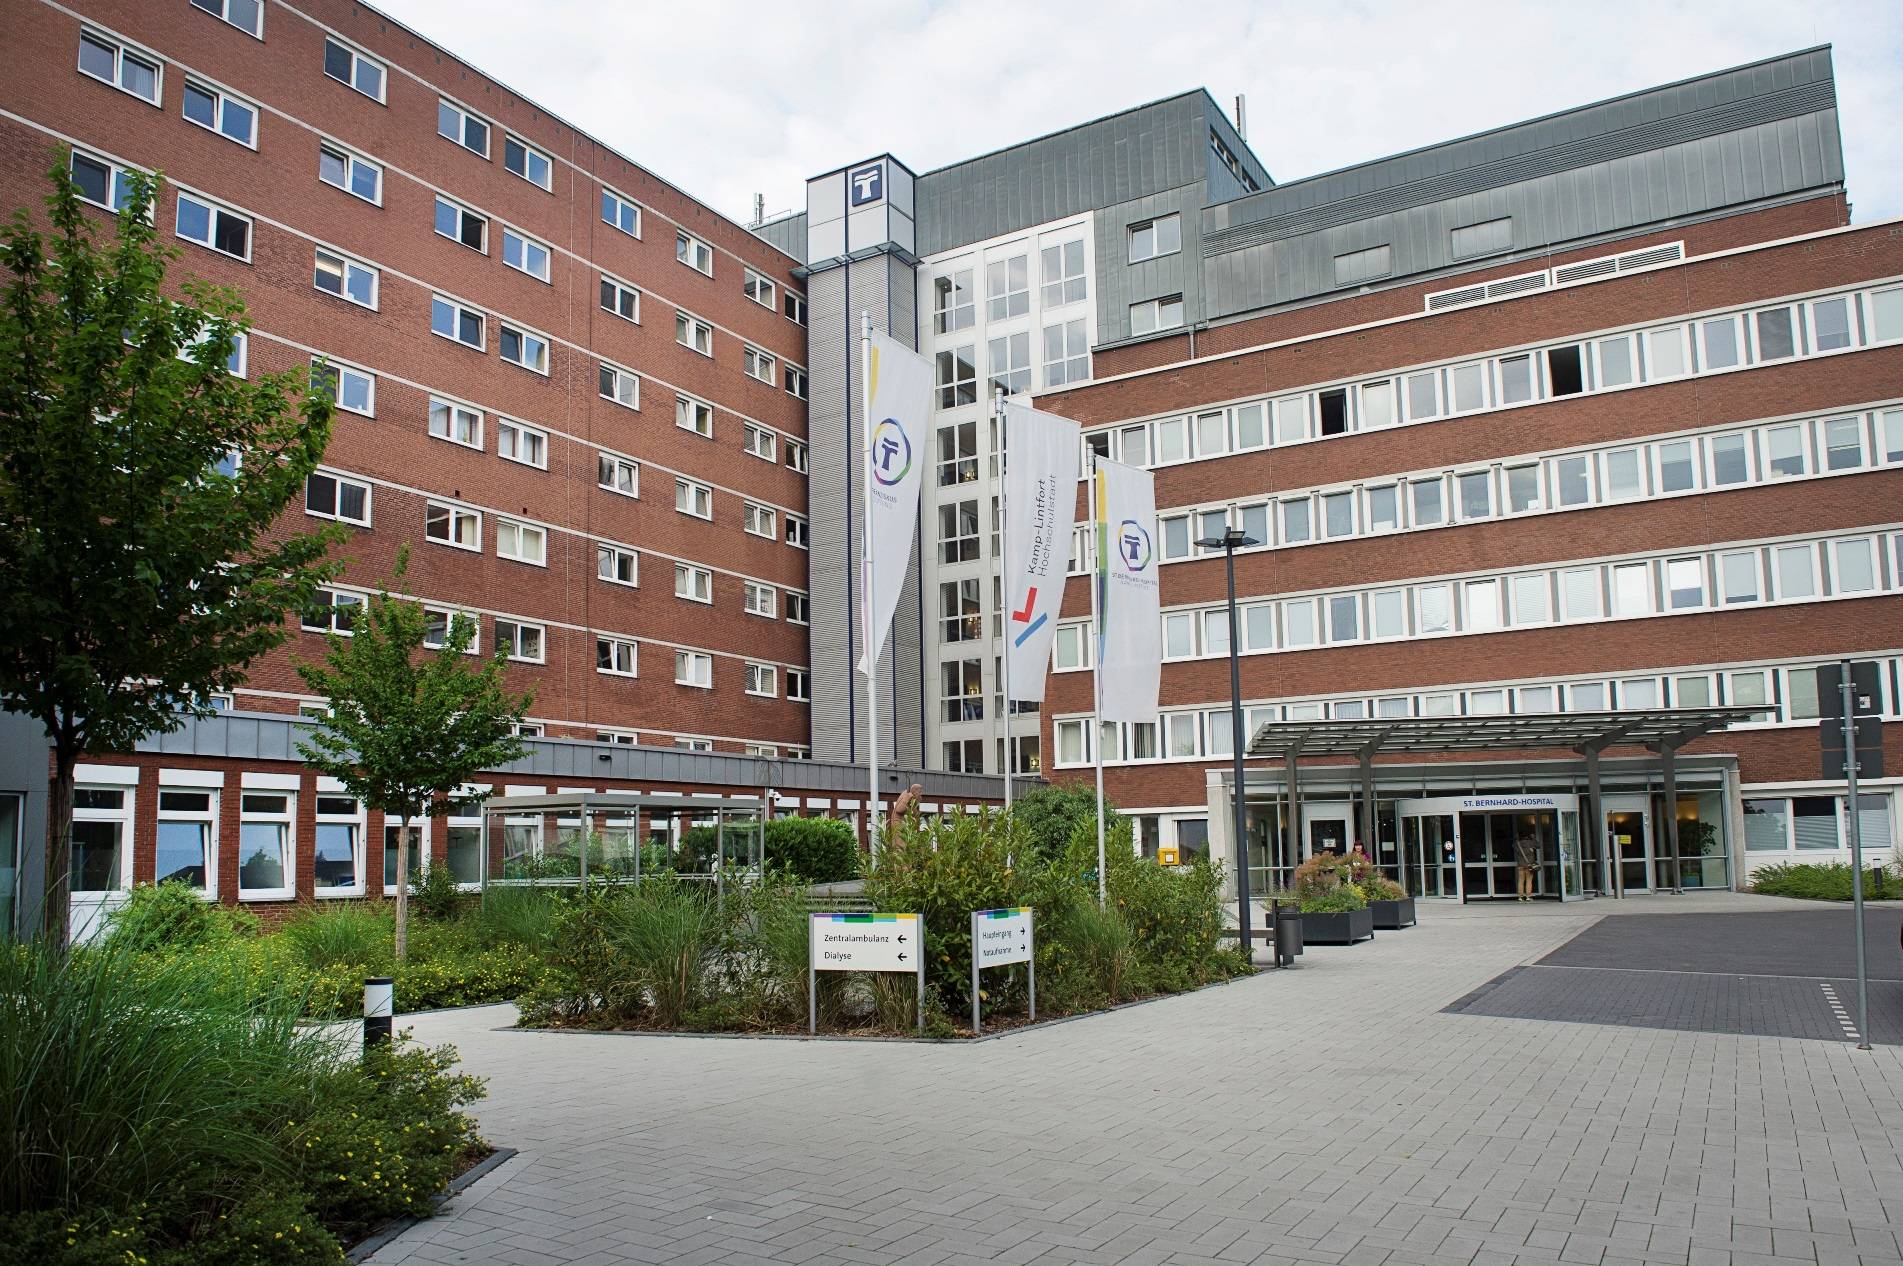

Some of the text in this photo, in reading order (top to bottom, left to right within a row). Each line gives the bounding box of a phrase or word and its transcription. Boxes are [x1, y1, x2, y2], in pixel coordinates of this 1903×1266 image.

[1028, 479, 1045, 574] Kamp-Lintfort
[1038, 473, 1056, 577] Hochschulstadt
[1475, 798, 1554, 807] BERNHARD-HOSPITAL
[824, 934, 889, 943] Zentralambulanz
[824, 951, 852, 962] Dialyse
